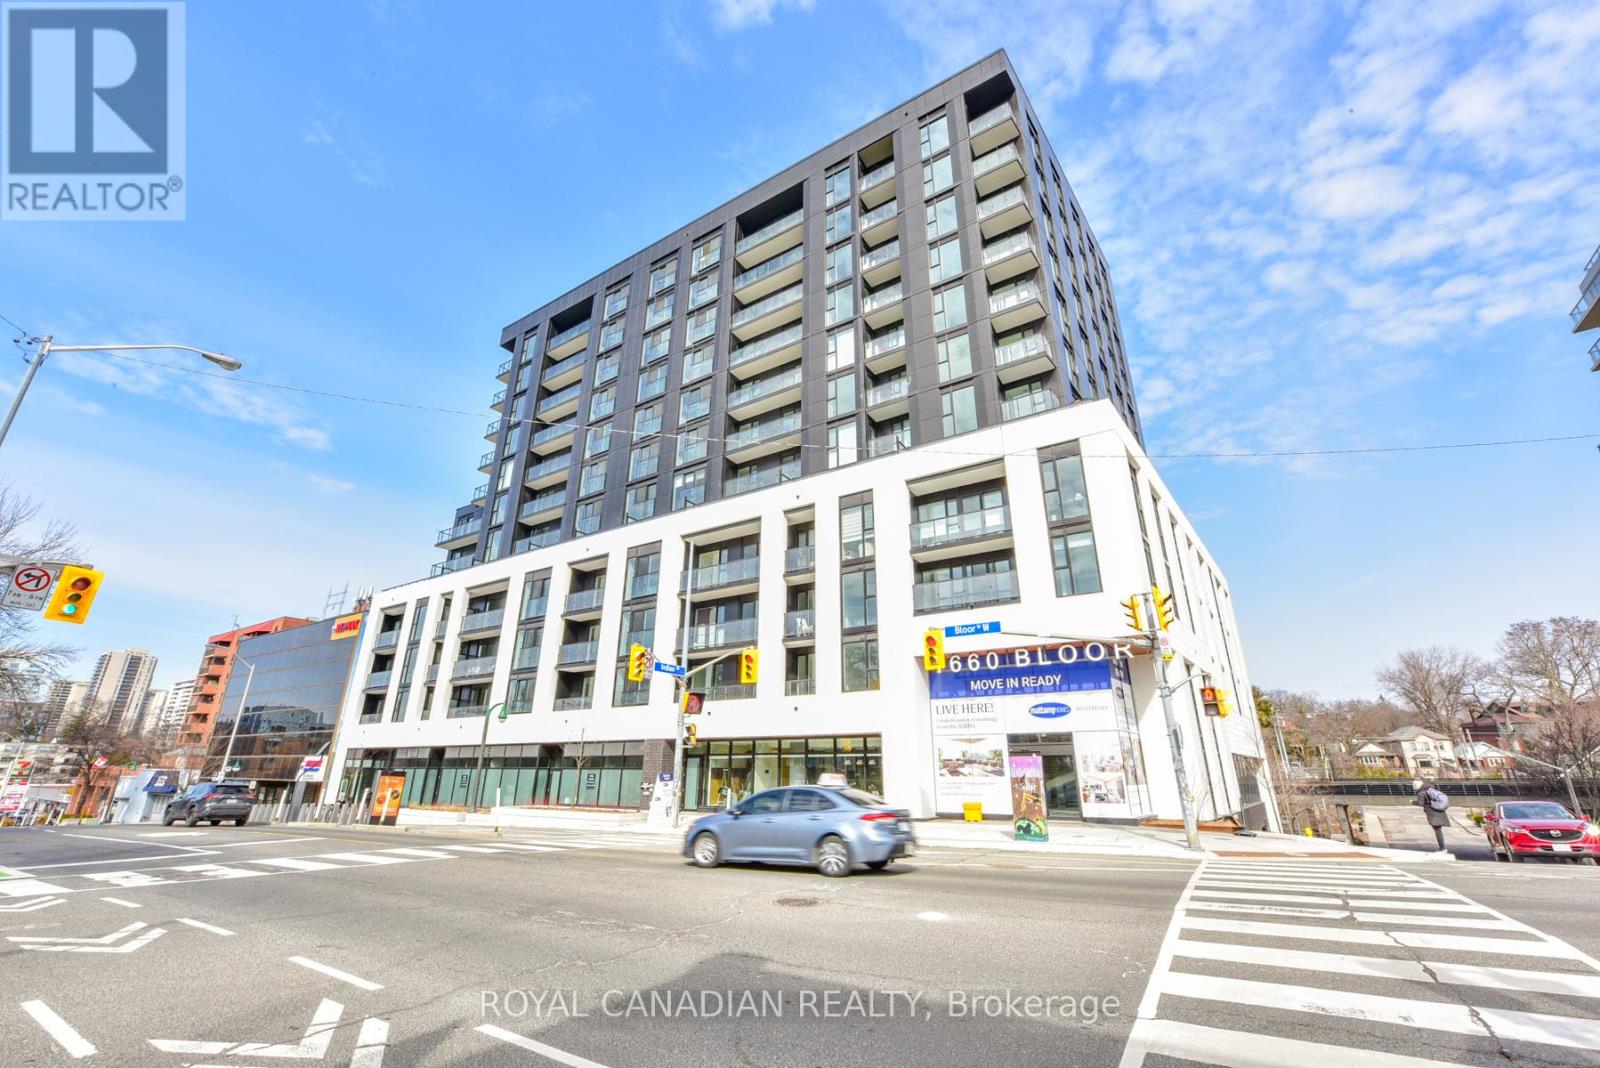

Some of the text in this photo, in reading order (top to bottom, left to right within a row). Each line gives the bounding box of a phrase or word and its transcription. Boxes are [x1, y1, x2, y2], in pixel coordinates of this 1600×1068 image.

[954, 625, 976, 635] Bloor
[982, 623, 990, 632] W
[937, 651, 999, 674] 660
[1014, 641, 1135, 668] BLOOR
[970, 674, 1061, 691] MOVE IN READY
[935, 702, 994, 716] LIVE HERE!
